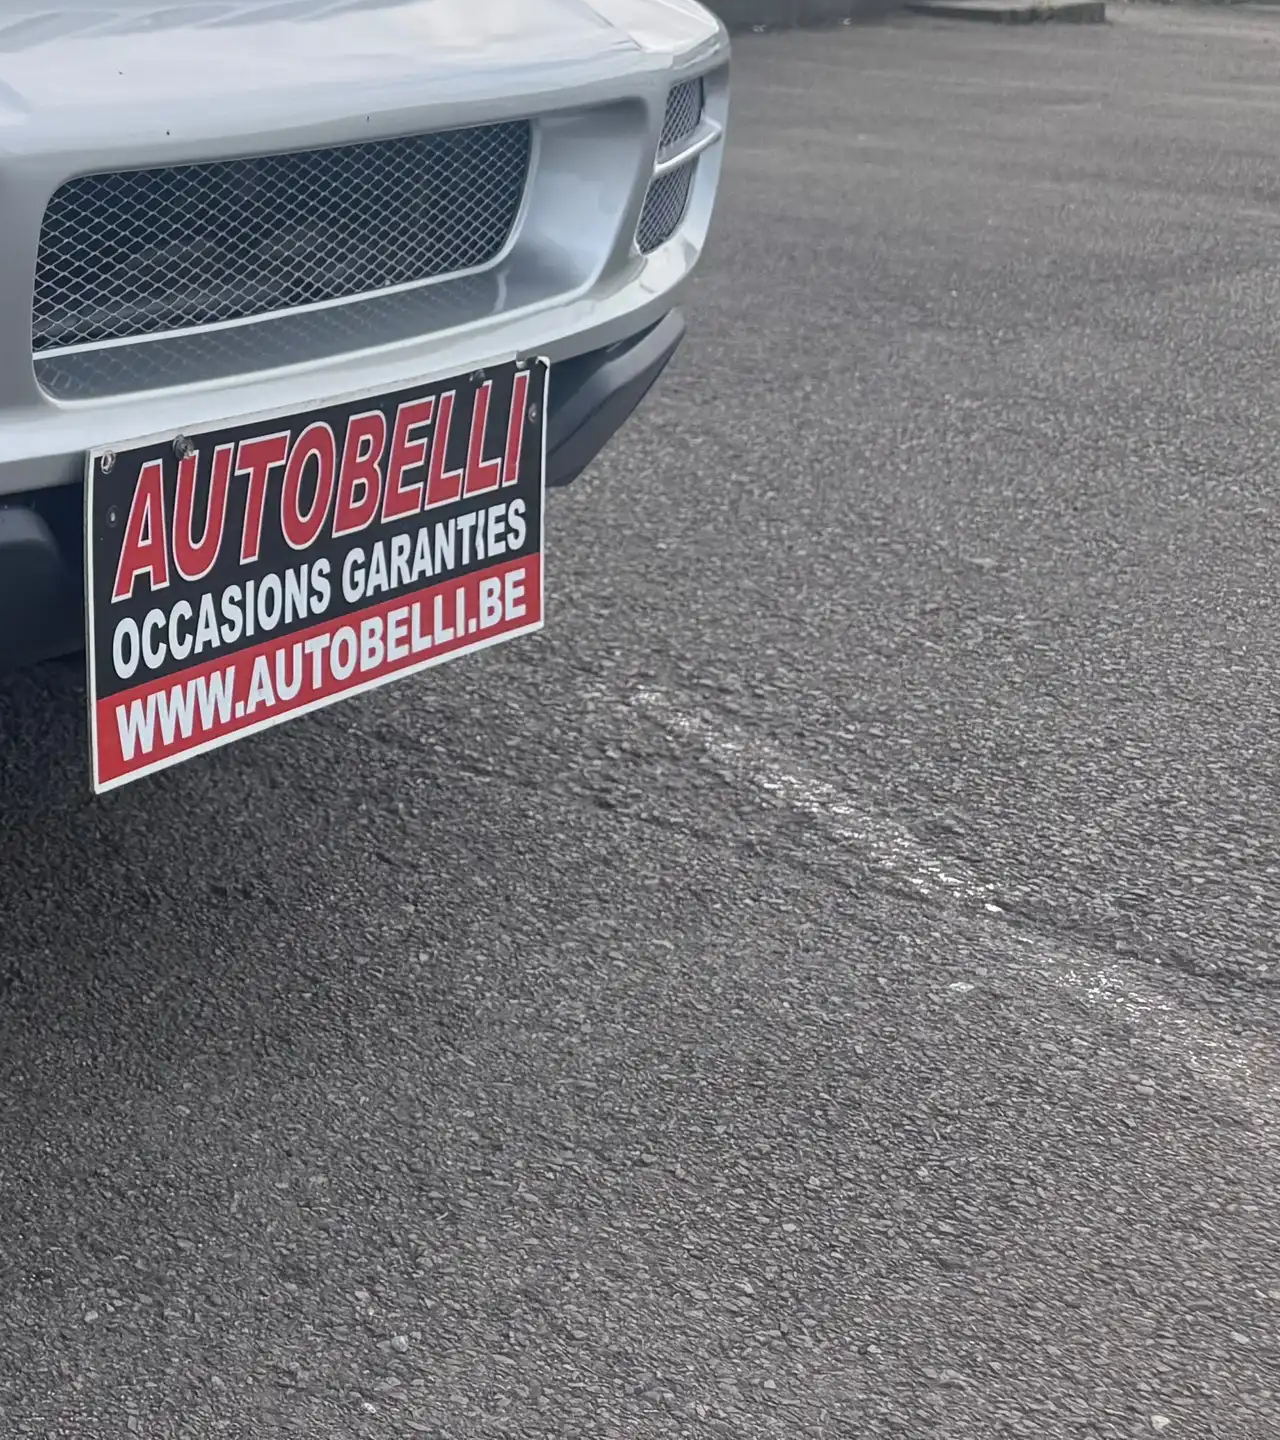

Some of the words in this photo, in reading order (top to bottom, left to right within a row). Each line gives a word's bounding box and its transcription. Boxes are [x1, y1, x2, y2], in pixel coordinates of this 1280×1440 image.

[110, 369, 531, 604] AUTOBELLI
[112, 558, 331, 680] OCCASIONS
[342, 498, 527, 604] GARANTIES
[115, 567, 527, 762] WWW.AUTOBELLI.BE
